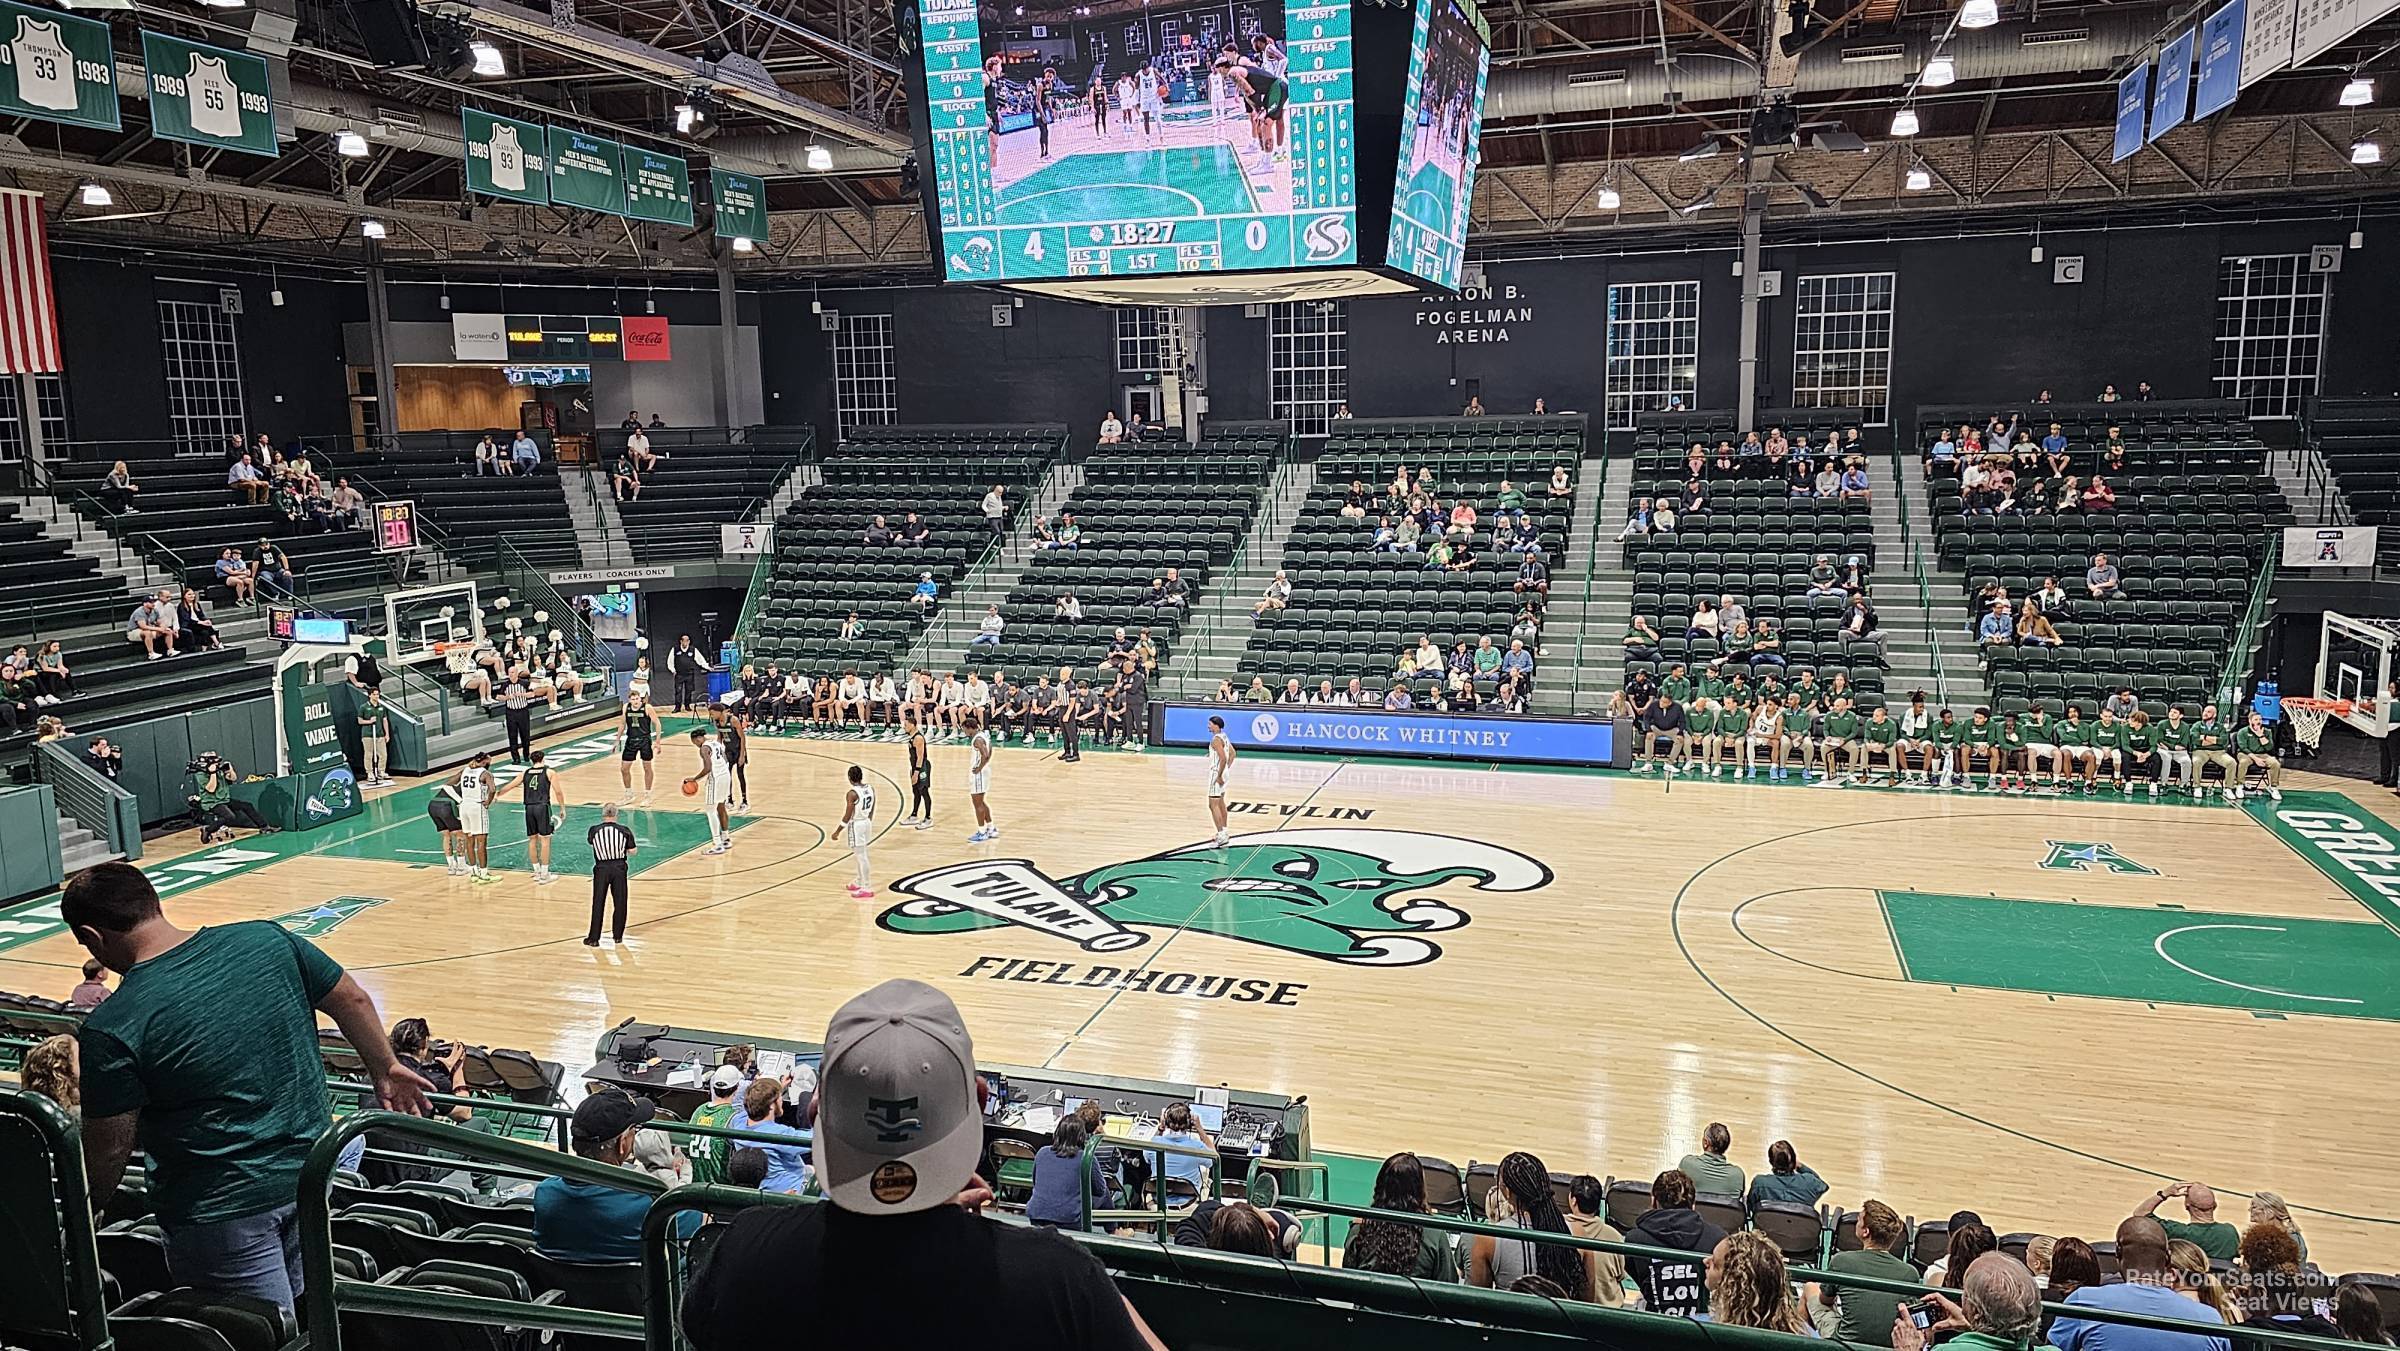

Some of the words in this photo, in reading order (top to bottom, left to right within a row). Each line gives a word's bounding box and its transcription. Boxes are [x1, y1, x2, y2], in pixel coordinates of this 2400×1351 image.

[926, 14, 975, 24] REBOUNDS
[1297, 10, 1337, 21] ASSISTS
[948, 26, 957, 39] 2
[1313, 25, 1322, 38] 0
[23, 43, 62, 59] THOMPSON
[936, 45, 971, 54] ASSISTS
[1300, 42, 1336, 53] STEALS
[34, 56, 57, 81] 33
[951, 57, 959, 69] 1
[1314, 57, 1323, 69] 0
[76, 59, 110, 85] 1983
[941, 74, 972, 83] STEALS
[1301, 73, 1339, 84] BLOCKS
[153, 73, 186, 97] 1989
[204, 79, 220, 89] REED
[954, 86, 962, 97] 0
[1314, 88, 1323, 100] 0
[205, 91, 224, 111] 55
[240, 91, 269, 114] 1993
[942, 103, 976, 112] BLOCKS
[1291, 108, 1305, 117] PL
[1338, 104, 1346, 114] F
[956, 115, 965, 126] 0
[1293, 123, 1301, 133] 1
[1317, 121, 1324, 132] 0
[1340, 120, 1347, 130] 0
[937, 133, 949, 141] PL
[977, 131, 984, 139] F
[468, 140, 490, 160] 1989
[939, 147, 946, 156] 1
[960, 146, 967, 156] 0
[979, 145, 986, 154] 0
[1293, 141, 1301, 151] 4
[1318, 139, 1325, 150] 0
[1340, 138, 1348, 148] 0
[501, 152, 513, 170] 93
[524, 154, 543, 171] 1993
[565, 149, 580, 160] MEN'S
[581, 154, 608, 167] BASKETBALL
[1292, 159, 1306, 169] 15
[1341, 156, 1348, 167] 1
[559, 158, 587, 171] CONFERENCE
[588, 164, 613, 176] CHAMPIONS
[941, 164, 949, 173] 5
[961, 163, 968, 173] 0
[981, 162, 988, 171] 0
[652, 173, 674, 183] BASKETBALL
[1293, 177, 1306, 187] 24
[1319, 176, 1326, 186] 0
[1342, 174, 1349, 184] 0
[1293, 195, 1307, 205] 31
[1319, 194, 1326, 204] 0
[1342, 192, 1349, 202] 0
[944, 214, 956, 224] 25
[966, 213, 973, 223] 0
[985, 211, 992, 222] 0
[1111, 221, 1175, 244] 18:27
[1245, 220, 1267, 251] 0
[1024, 231, 1045, 262] 4
[1181, 246, 1201, 257] FLS
[1211, 245, 1218, 255] 1
[1070, 251, 1091, 261] FLS
[1099, 250, 1107, 260] 0
[1128, 253, 1158, 269] 1ST
[2319, 254, 2334, 269] D
[1071, 265, 1088, 275] TO
[1100, 264, 1108, 275] 4
[1183, 259, 1200, 270] TO
[1211, 258, 1219, 268] 4
[1465, 272, 1478, 286] A
[2063, 265, 2075, 280] C
[1506, 285, 1526, 299] B.
[1764, 280, 1773, 293] B
[227, 297, 237, 311] R
[826, 316, 835, 329] R
[998, 312, 1006, 324] S
[1416, 308, 1533, 325] FOGELMAN
[469, 332, 491, 340] waters
[508, 331, 543, 342] TULANE
[1437, 328, 1510, 344] ARENA
[384, 521, 409, 545] 30
[558, 572, 593, 581] PLAYERS
[606, 569, 643, 579] COACHES
[646, 568, 667, 576] ONLY
[277, 622, 291, 634] 30
[304, 702, 331, 722] ROLL
[304, 725, 338, 747] WAVE
[1287, 722, 1390, 742] HANCOCK
[1398, 727, 1512, 746] WHITNEY
[463, 776, 477, 789] 25
[529, 775, 539, 790] 4
[862, 796, 872, 810] 12
[1226, 800, 1376, 821] DEVLIN
[2276, 809, 2400, 908] GRE
[952, 872, 1085, 931] TULANE
[958, 955, 1310, 1007] FIELDHOUSE
[690, 1134, 711, 1159] 24
